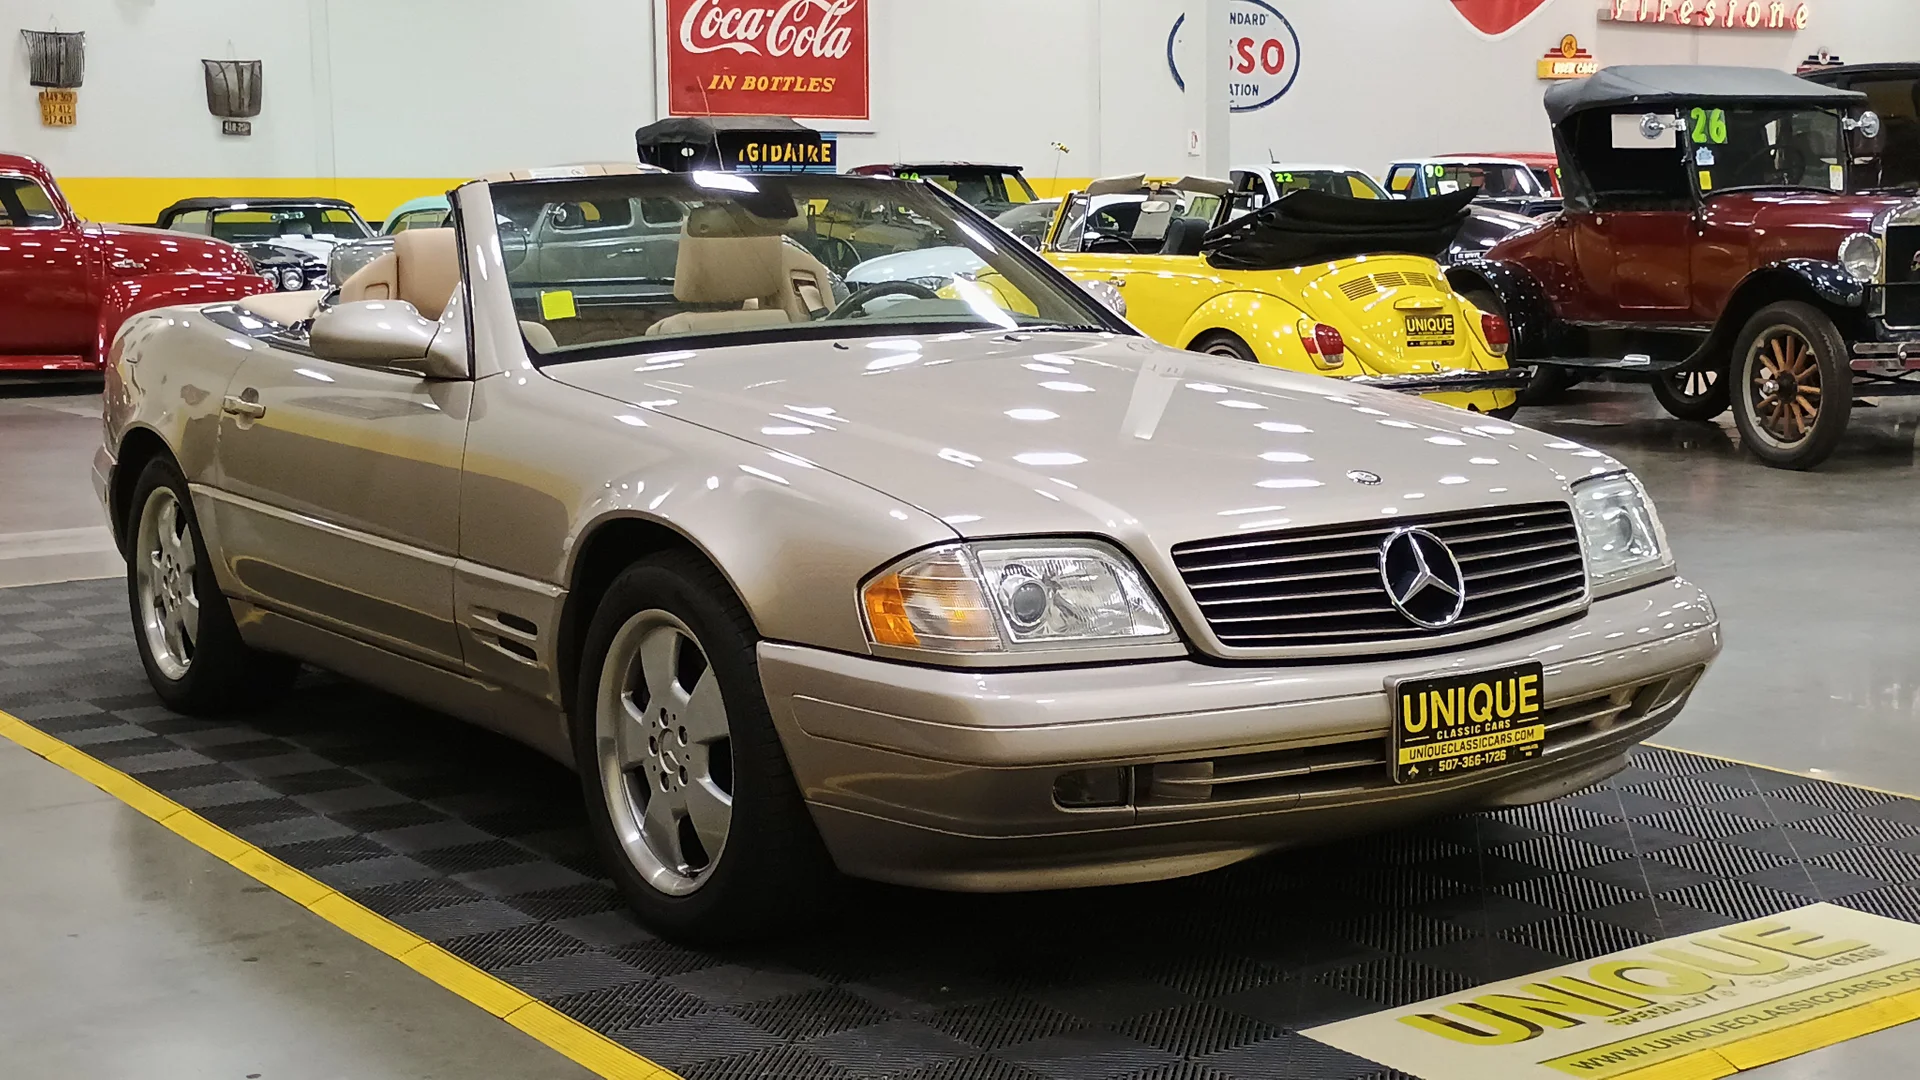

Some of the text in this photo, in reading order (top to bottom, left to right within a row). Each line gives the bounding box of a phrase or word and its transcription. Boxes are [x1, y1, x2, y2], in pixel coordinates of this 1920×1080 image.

[680, 0, 858, 59] Coca-Cola
[1229, 37, 1285, 75] SO
[708, 75, 836, 92] IN BOTTLES
[1690, 107, 1728, 144] 26
[1274, 172, 1294, 182] 22
[1425, 164, 1444, 178] 90
[1406, 317, 1454, 332] UNIQUE
[1403, 674, 1539, 733] UNIQUE
[1409, 728, 1535, 760] UNIQUECLASSICCARS.COM
[1436, 719, 1511, 740] CLASSIC CARS
[1438, 749, 1507, 772] 507-366-1726
[1396, 921, 1871, 1046] UNIQUE
[1569, 967, 1920, 1070] WWW.UNIQUECLASSICCARS.CO
